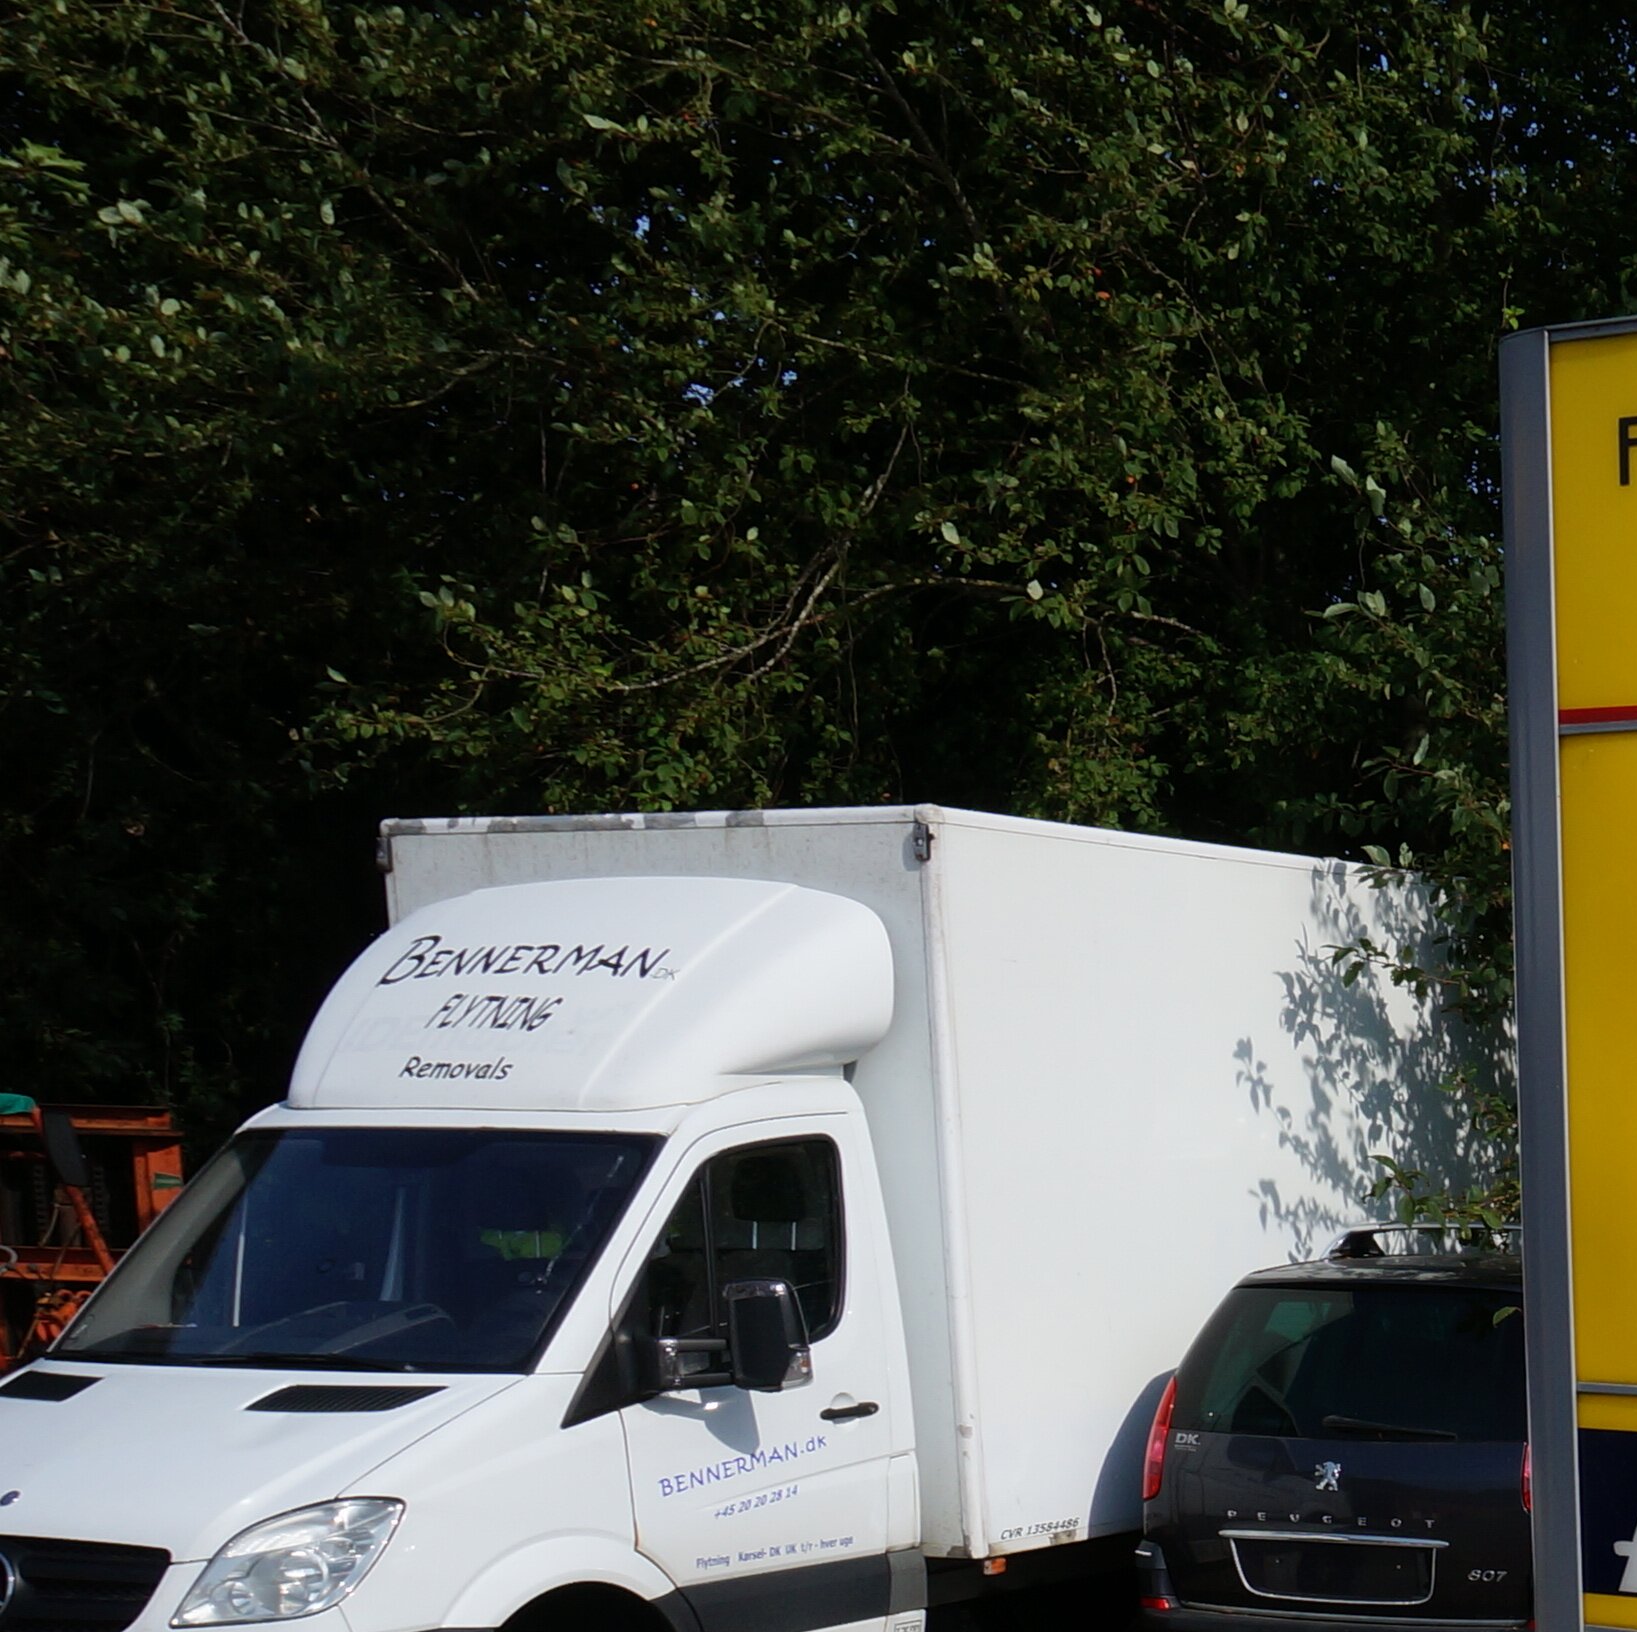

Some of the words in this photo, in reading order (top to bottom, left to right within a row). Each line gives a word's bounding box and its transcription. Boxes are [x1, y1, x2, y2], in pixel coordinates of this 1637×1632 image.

[424, 993, 563, 1032] FLYTNING
[399, 1056, 514, 1080] Removals
[658, 1434, 828, 1497] BENNERMAN.dk
[1227, 1510, 1436, 1530] PEUGEOT
[1001, 1527, 1023, 1540] CVR
[1467, 1568, 1508, 1583] 807
